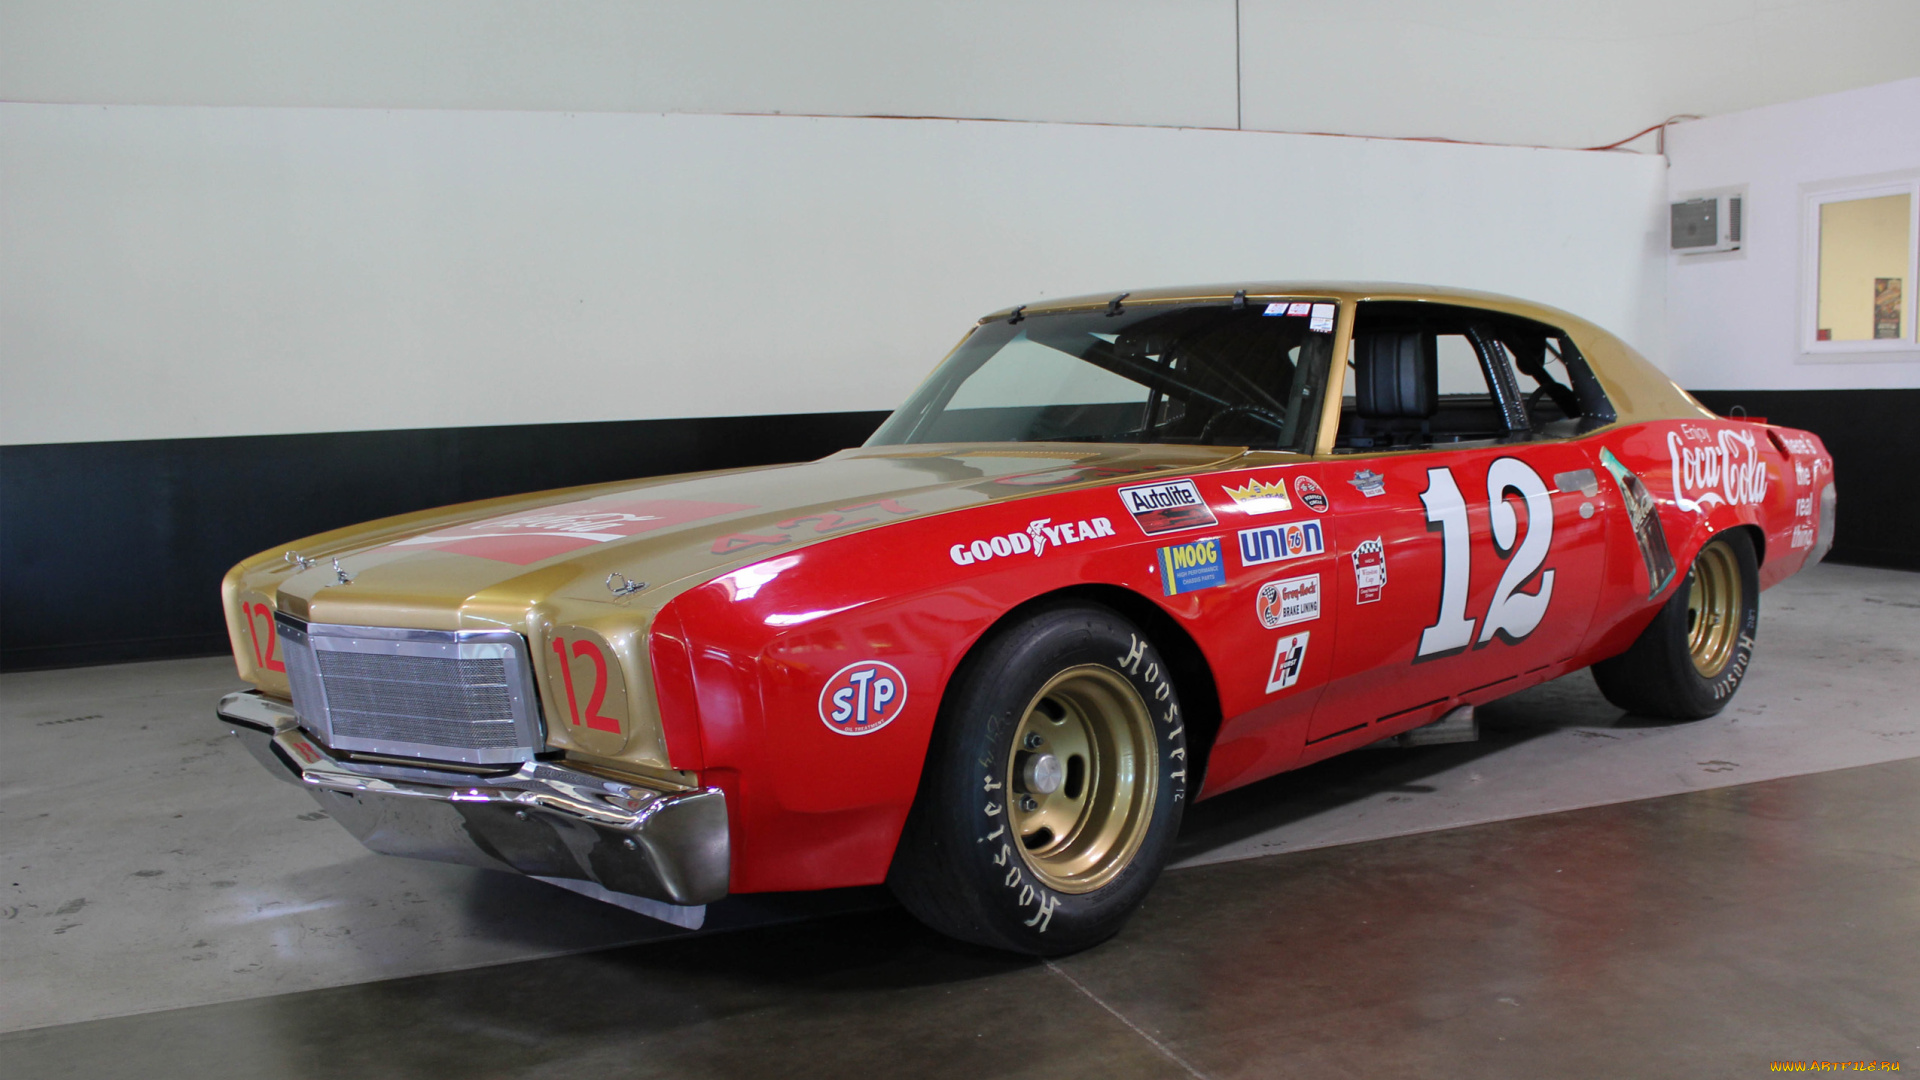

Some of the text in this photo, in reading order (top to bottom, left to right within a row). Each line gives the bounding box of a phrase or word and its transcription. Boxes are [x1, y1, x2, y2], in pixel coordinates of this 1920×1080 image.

[1680, 423, 1712, 443] Enjoy
[1795, 460, 1811, 486] the
[1131, 486, 1196, 511] Autolite
[1796, 492, 1813, 517] real
[711, 499, 920, 555] 427
[1289, 532, 1301, 548] 76
[1172, 541, 1217, 570] MOOG
[1411, 456, 1556, 664] 12
[1183, 577, 1202, 585] CHASSIS
[1188, 565, 1219, 576] PERFORMANCE
[1283, 601, 1317, 618] BRAKE LINING
[242, 601, 286, 674] 12
[551, 636, 621, 735] 12
[831, 668, 896, 725] STP
[1118, 633, 1186, 784] Hoosier
[977, 775, 1061, 932] Hoosier
